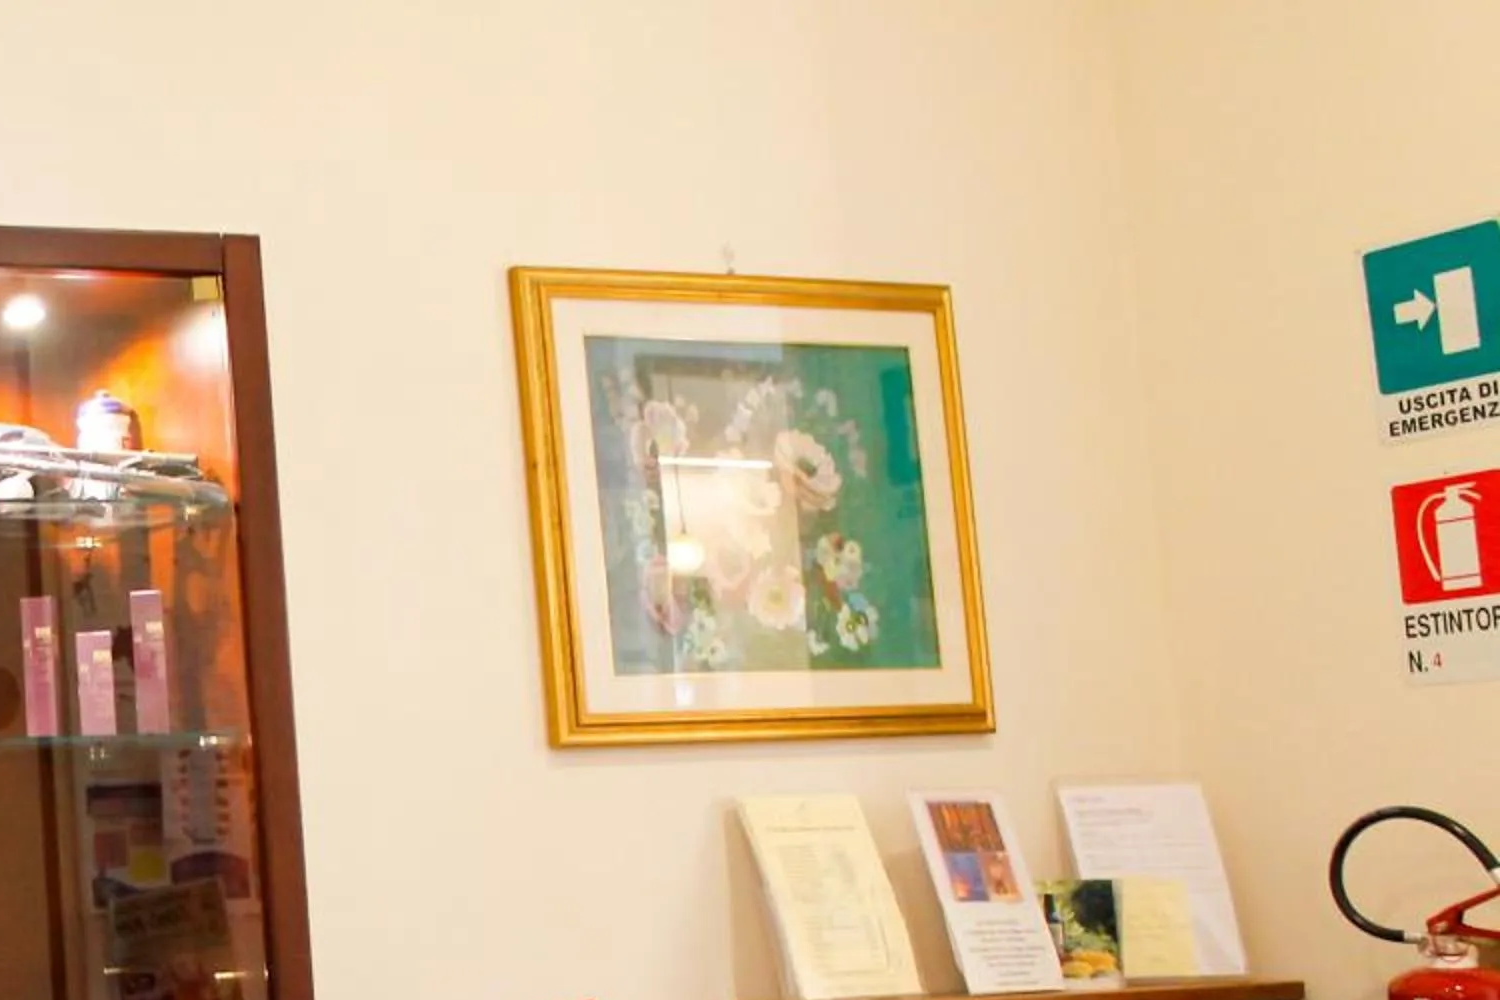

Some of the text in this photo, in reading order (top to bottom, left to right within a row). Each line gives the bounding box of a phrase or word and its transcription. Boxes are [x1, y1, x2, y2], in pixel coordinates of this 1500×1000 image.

[1398, 380, 1499, 414] USCITA DI
[1389, 401, 1500, 437] EMERGENZ
[1408, 650, 1442, 673] N. 4
